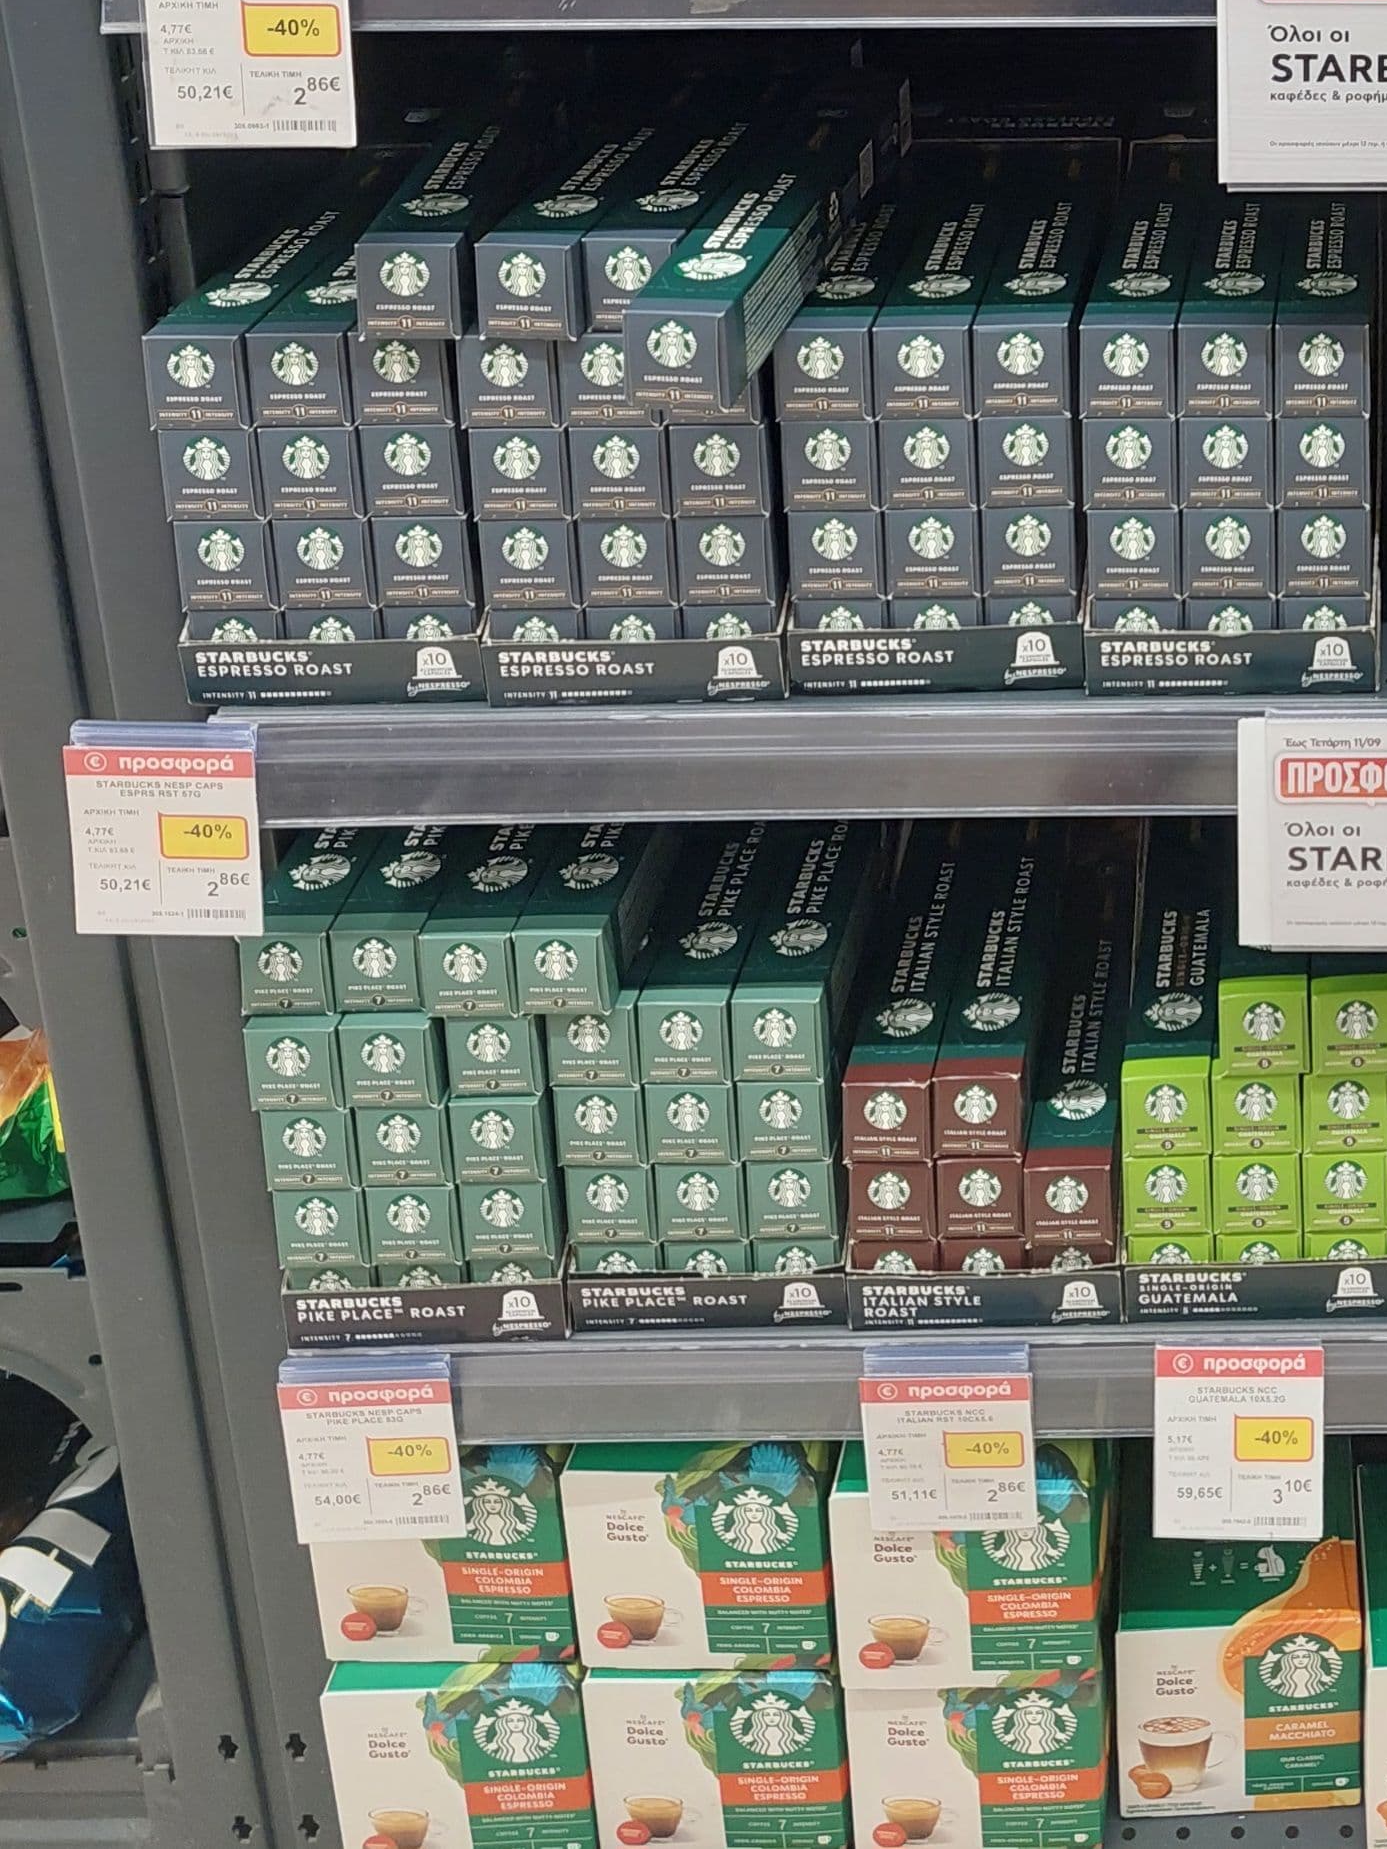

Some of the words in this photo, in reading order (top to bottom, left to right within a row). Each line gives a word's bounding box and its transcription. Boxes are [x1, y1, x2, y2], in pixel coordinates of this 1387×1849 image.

[267, 19, 320, 38] -40%
[1268, 25, 1321, 45] Όλοι
[1330, 30, 1350, 43] οι
[177, 84, 233, 101] 50,21€
[1270, 89, 1327, 104] καφέδες
[1332, 90, 1341, 102] &
[196, 650, 308, 664] STARBUCKS
[197, 663, 288, 678] ESPRESSO
[295, 662, 353, 676] ROAST
[119, 755, 235, 774] προσφορά
[183, 824, 232, 840] -40%
[1284, 821, 1334, 838] Όλοι
[1343, 825, 1361, 837] οι
[100, 878, 152, 892] 50,21€
[1139, 1272, 1242, 1284] STARBUCKS
[862, 1286, 965, 1297] STARBUCKS
[1139, 1292, 1238, 1305] GUATEMALA
[296, 1296, 402, 1310] STARBUCKS
[863, 1295, 925, 1307] ITALIAN
[931, 1295, 981, 1306] STYLE
[297, 1311, 332, 1324] PIKE
[411, 1306, 466, 1318] ROAST
[1204, 1353, 1306, 1374] προσφορά
[328, 1386, 434, 1405] προσφορά
[908, 1380, 1012, 1399] προσφορά
[1255, 1430, 1298, 1447] -40%
[387, 1444, 432, 1458] -40%
[965, 1442, 1010, 1456] -40%
[315, 1494, 361, 1506] 54,00€
[892, 1488, 938, 1502] 51,11€
[1177, 1486, 1223, 1501] 59,65€
[606, 1521, 645, 1532] Dolce
[606, 1531, 647, 1542] Gusto
[725, 1561, 793, 1569] STARBUCKS
[733, 1586, 791, 1594] COLOMBIA
[736, 1594, 790, 1603] ESPRESSO
